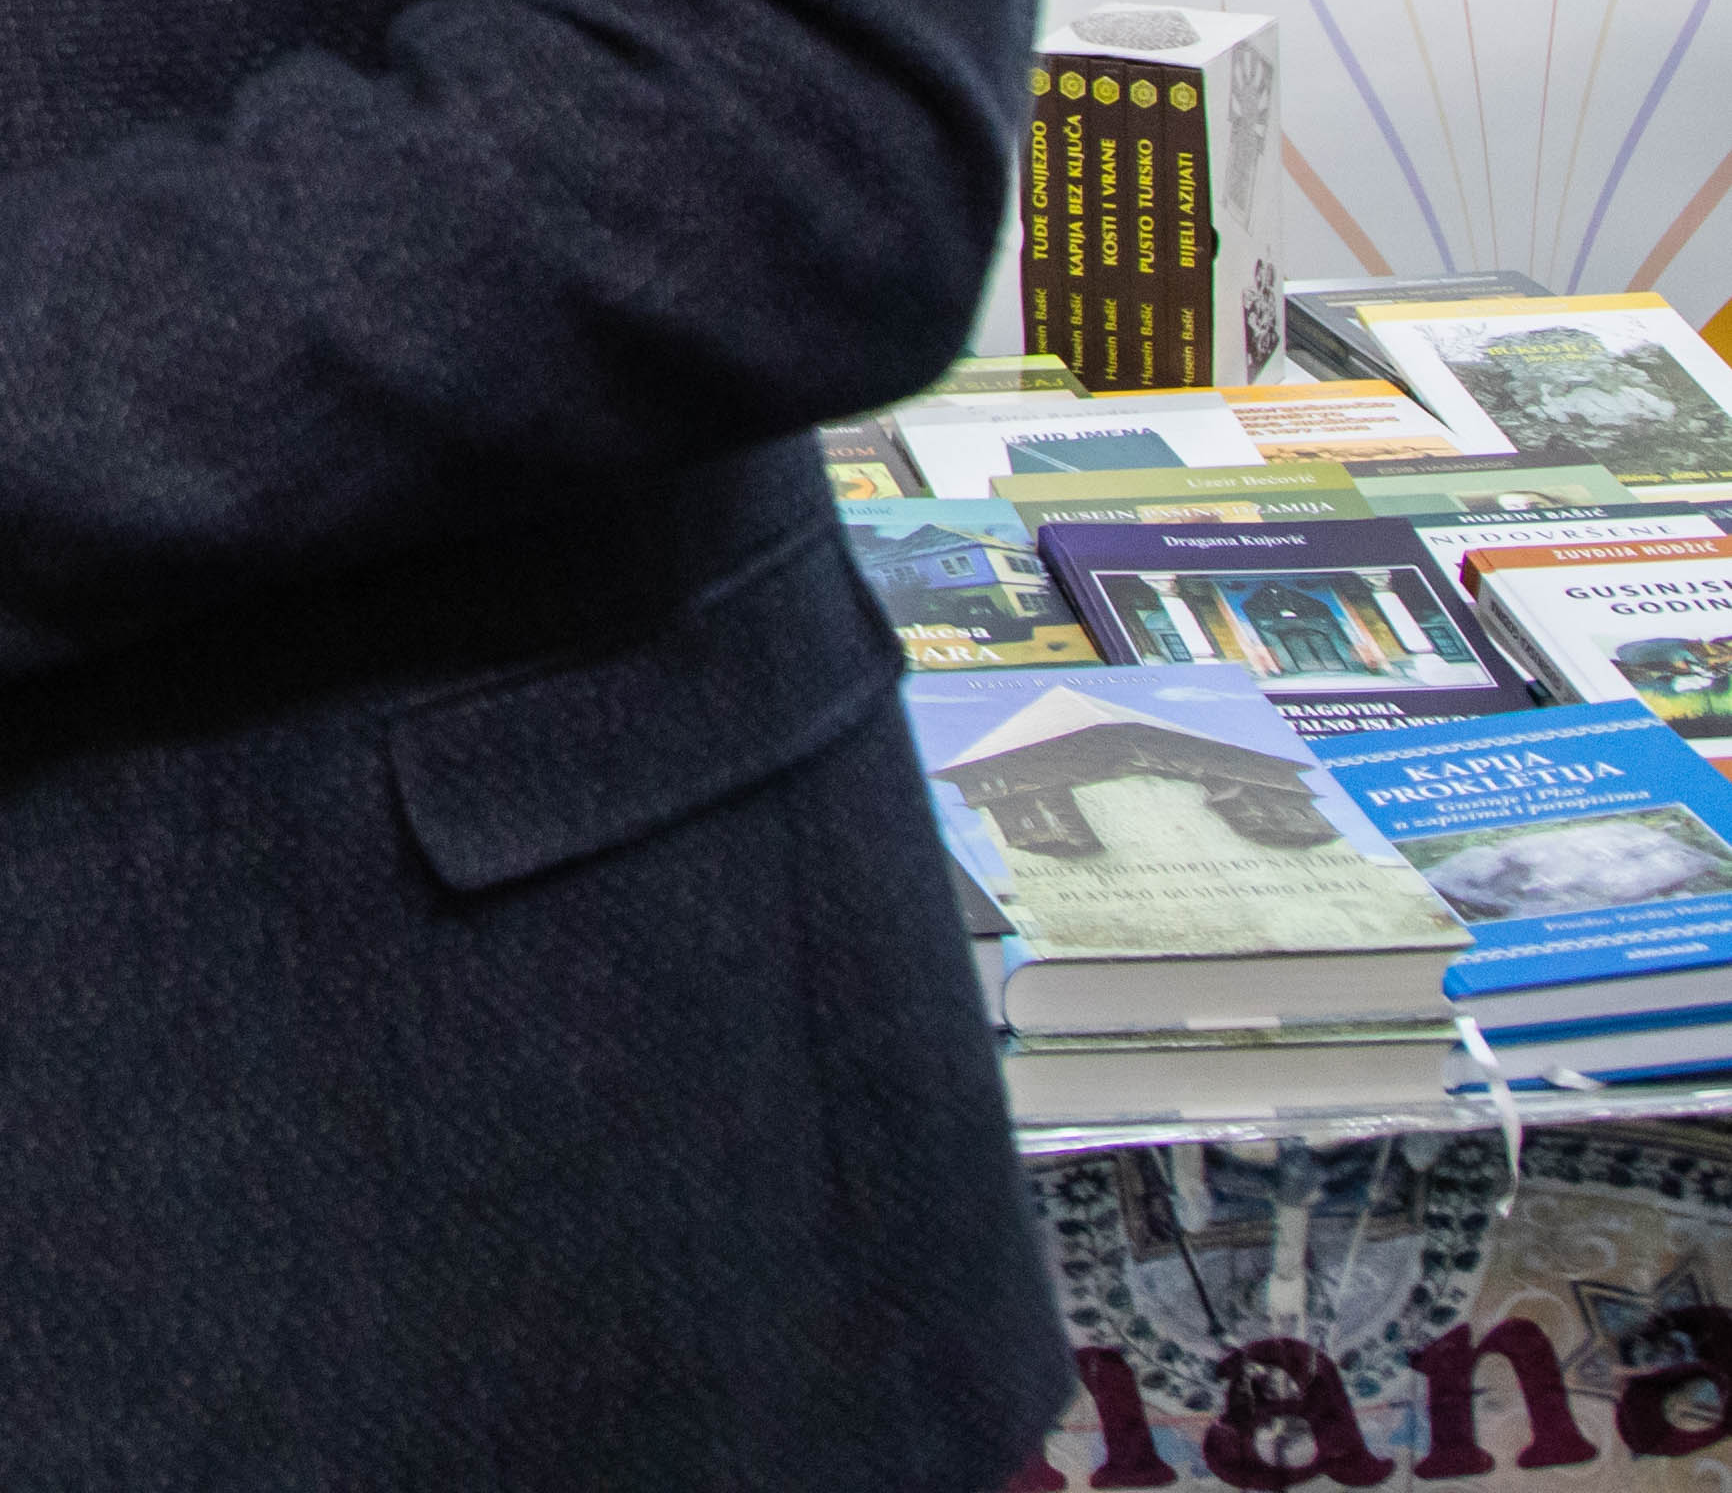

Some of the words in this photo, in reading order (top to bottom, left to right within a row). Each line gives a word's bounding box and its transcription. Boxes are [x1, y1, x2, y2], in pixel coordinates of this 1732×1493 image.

[1063, 113, 1083, 179] KLJUČA
[1032, 120, 1050, 209] GNIJEZDO
[1101, 137, 1118, 197] VRANE
[1137, 138, 1154, 210] TURSKO
[1068, 183, 1084, 216] BEZ
[1177, 151, 1195, 215] AZIJATI
[1102, 201, 1117, 210] I
[1069, 221, 1085, 277] KAPIJA
[1102, 216, 1119, 267] KOSTI
[1138, 215, 1155, 274] PUSTO
[1179, 220, 1196, 269] BIJELI
[1035, 287, 1049, 322] Bašić
[1069, 291, 1084, 326] Bašić
[1104, 297, 1118, 332] Bašić
[1139, 302, 1154, 337] Bašić
[1182, 307, 1196, 341] Bašić
[1105, 338, 1118, 381] Husein
[1140, 341, 1154, 386] Husein
[1186, 477, 1237, 490] Uzeir
[1428, 523, 1679, 546] NEDOVRŠENE
[1458, 511, 1542, 524] HUSEIN
[1161, 535, 1239, 550] Dragana
[1241, 532, 1307, 547] Kujović
[1642, 539, 1720, 556] HODŽIĆ
[1366, 761, 1626, 806] PROKLETIJA
[1402, 750, 1556, 784] KAPIJA
